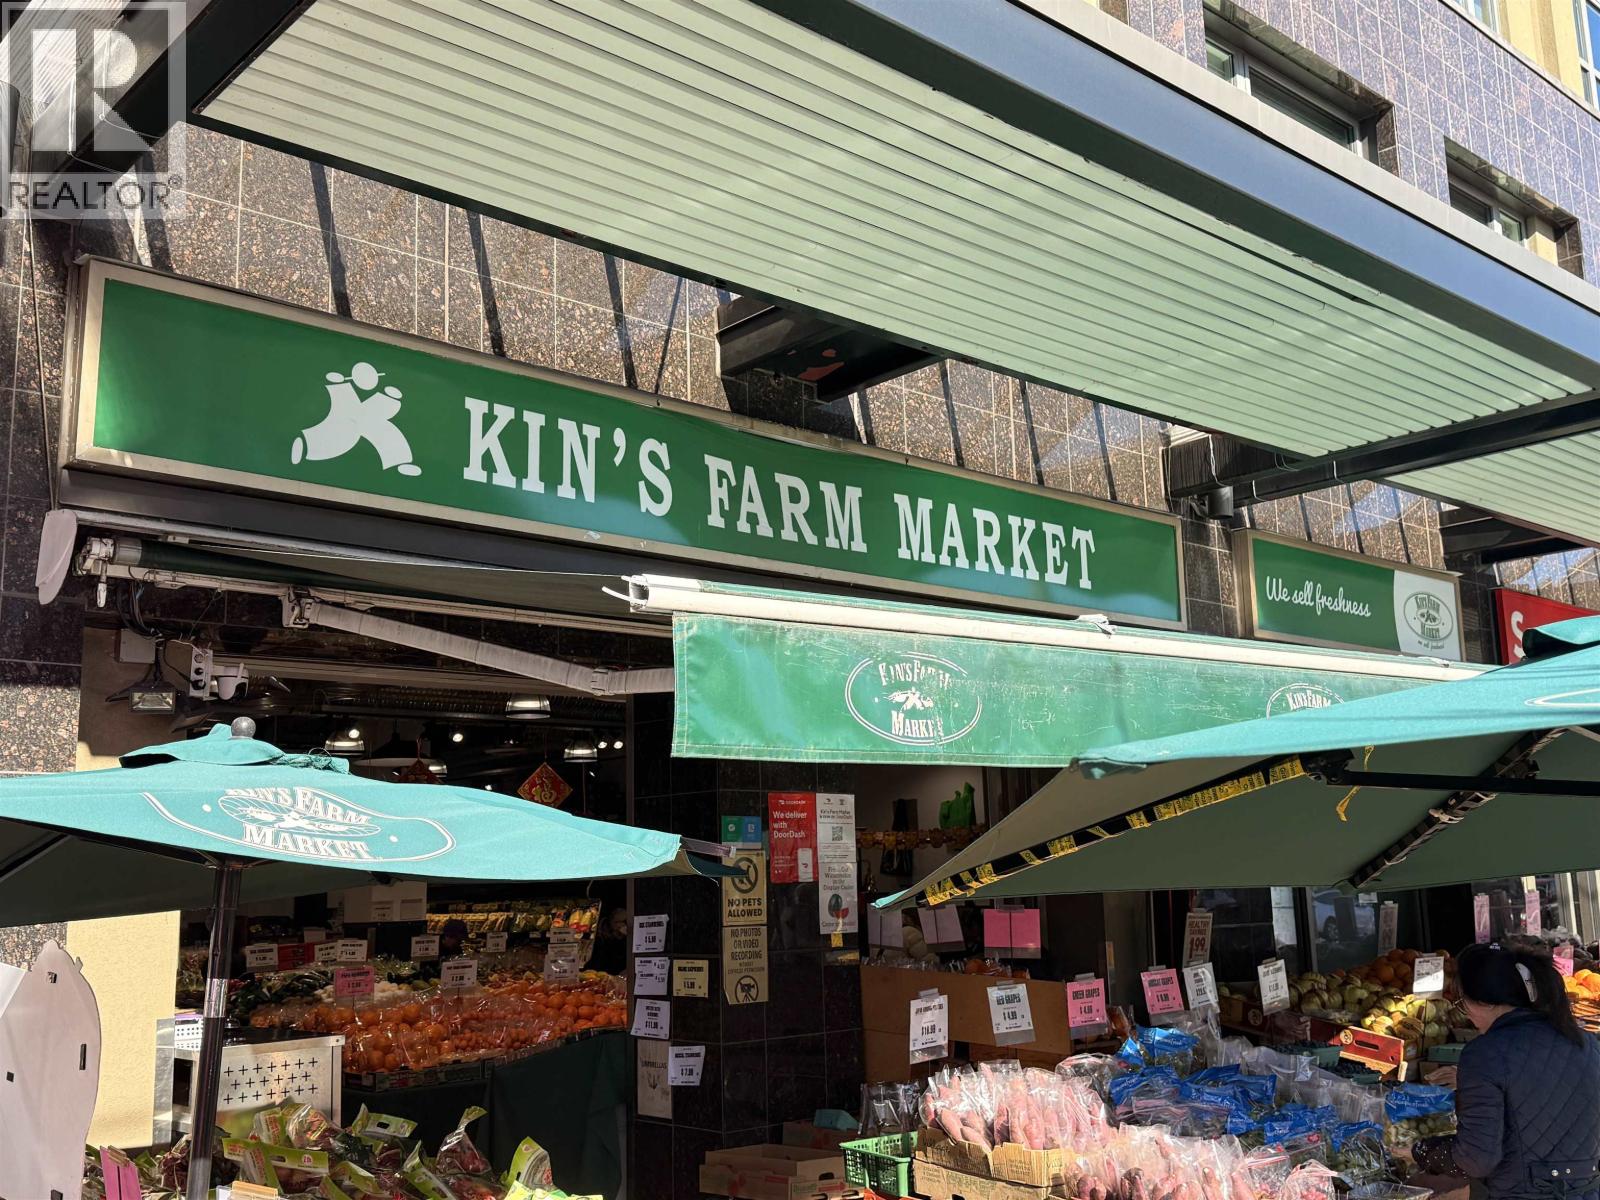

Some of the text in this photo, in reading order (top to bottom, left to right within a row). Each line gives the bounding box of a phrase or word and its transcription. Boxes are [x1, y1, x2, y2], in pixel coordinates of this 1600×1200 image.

[463, 395, 1096, 590] KIN'S FARM MARKET
[1265, 575, 1372, 618] We sell freshness
[292, 786, 372, 824] FARM
[772, 810, 785, 819] We
[785, 810, 808, 820] deliver
[773, 821, 788, 830] with
[773, 830, 806, 840] DoorDash
[242, 822, 374, 861] MARKET
[727, 897, 763, 908] NO PETS
[727, 908, 763, 919] ALLOWED
[730, 927, 762, 939] NO PHOTOS
[733, 938, 760, 950] OR VIDEO
[730, 950, 763, 961] RECORDING
[1004, 992, 1022, 1005] GRAPES
[1085, 987, 1100, 999] GRAPES
